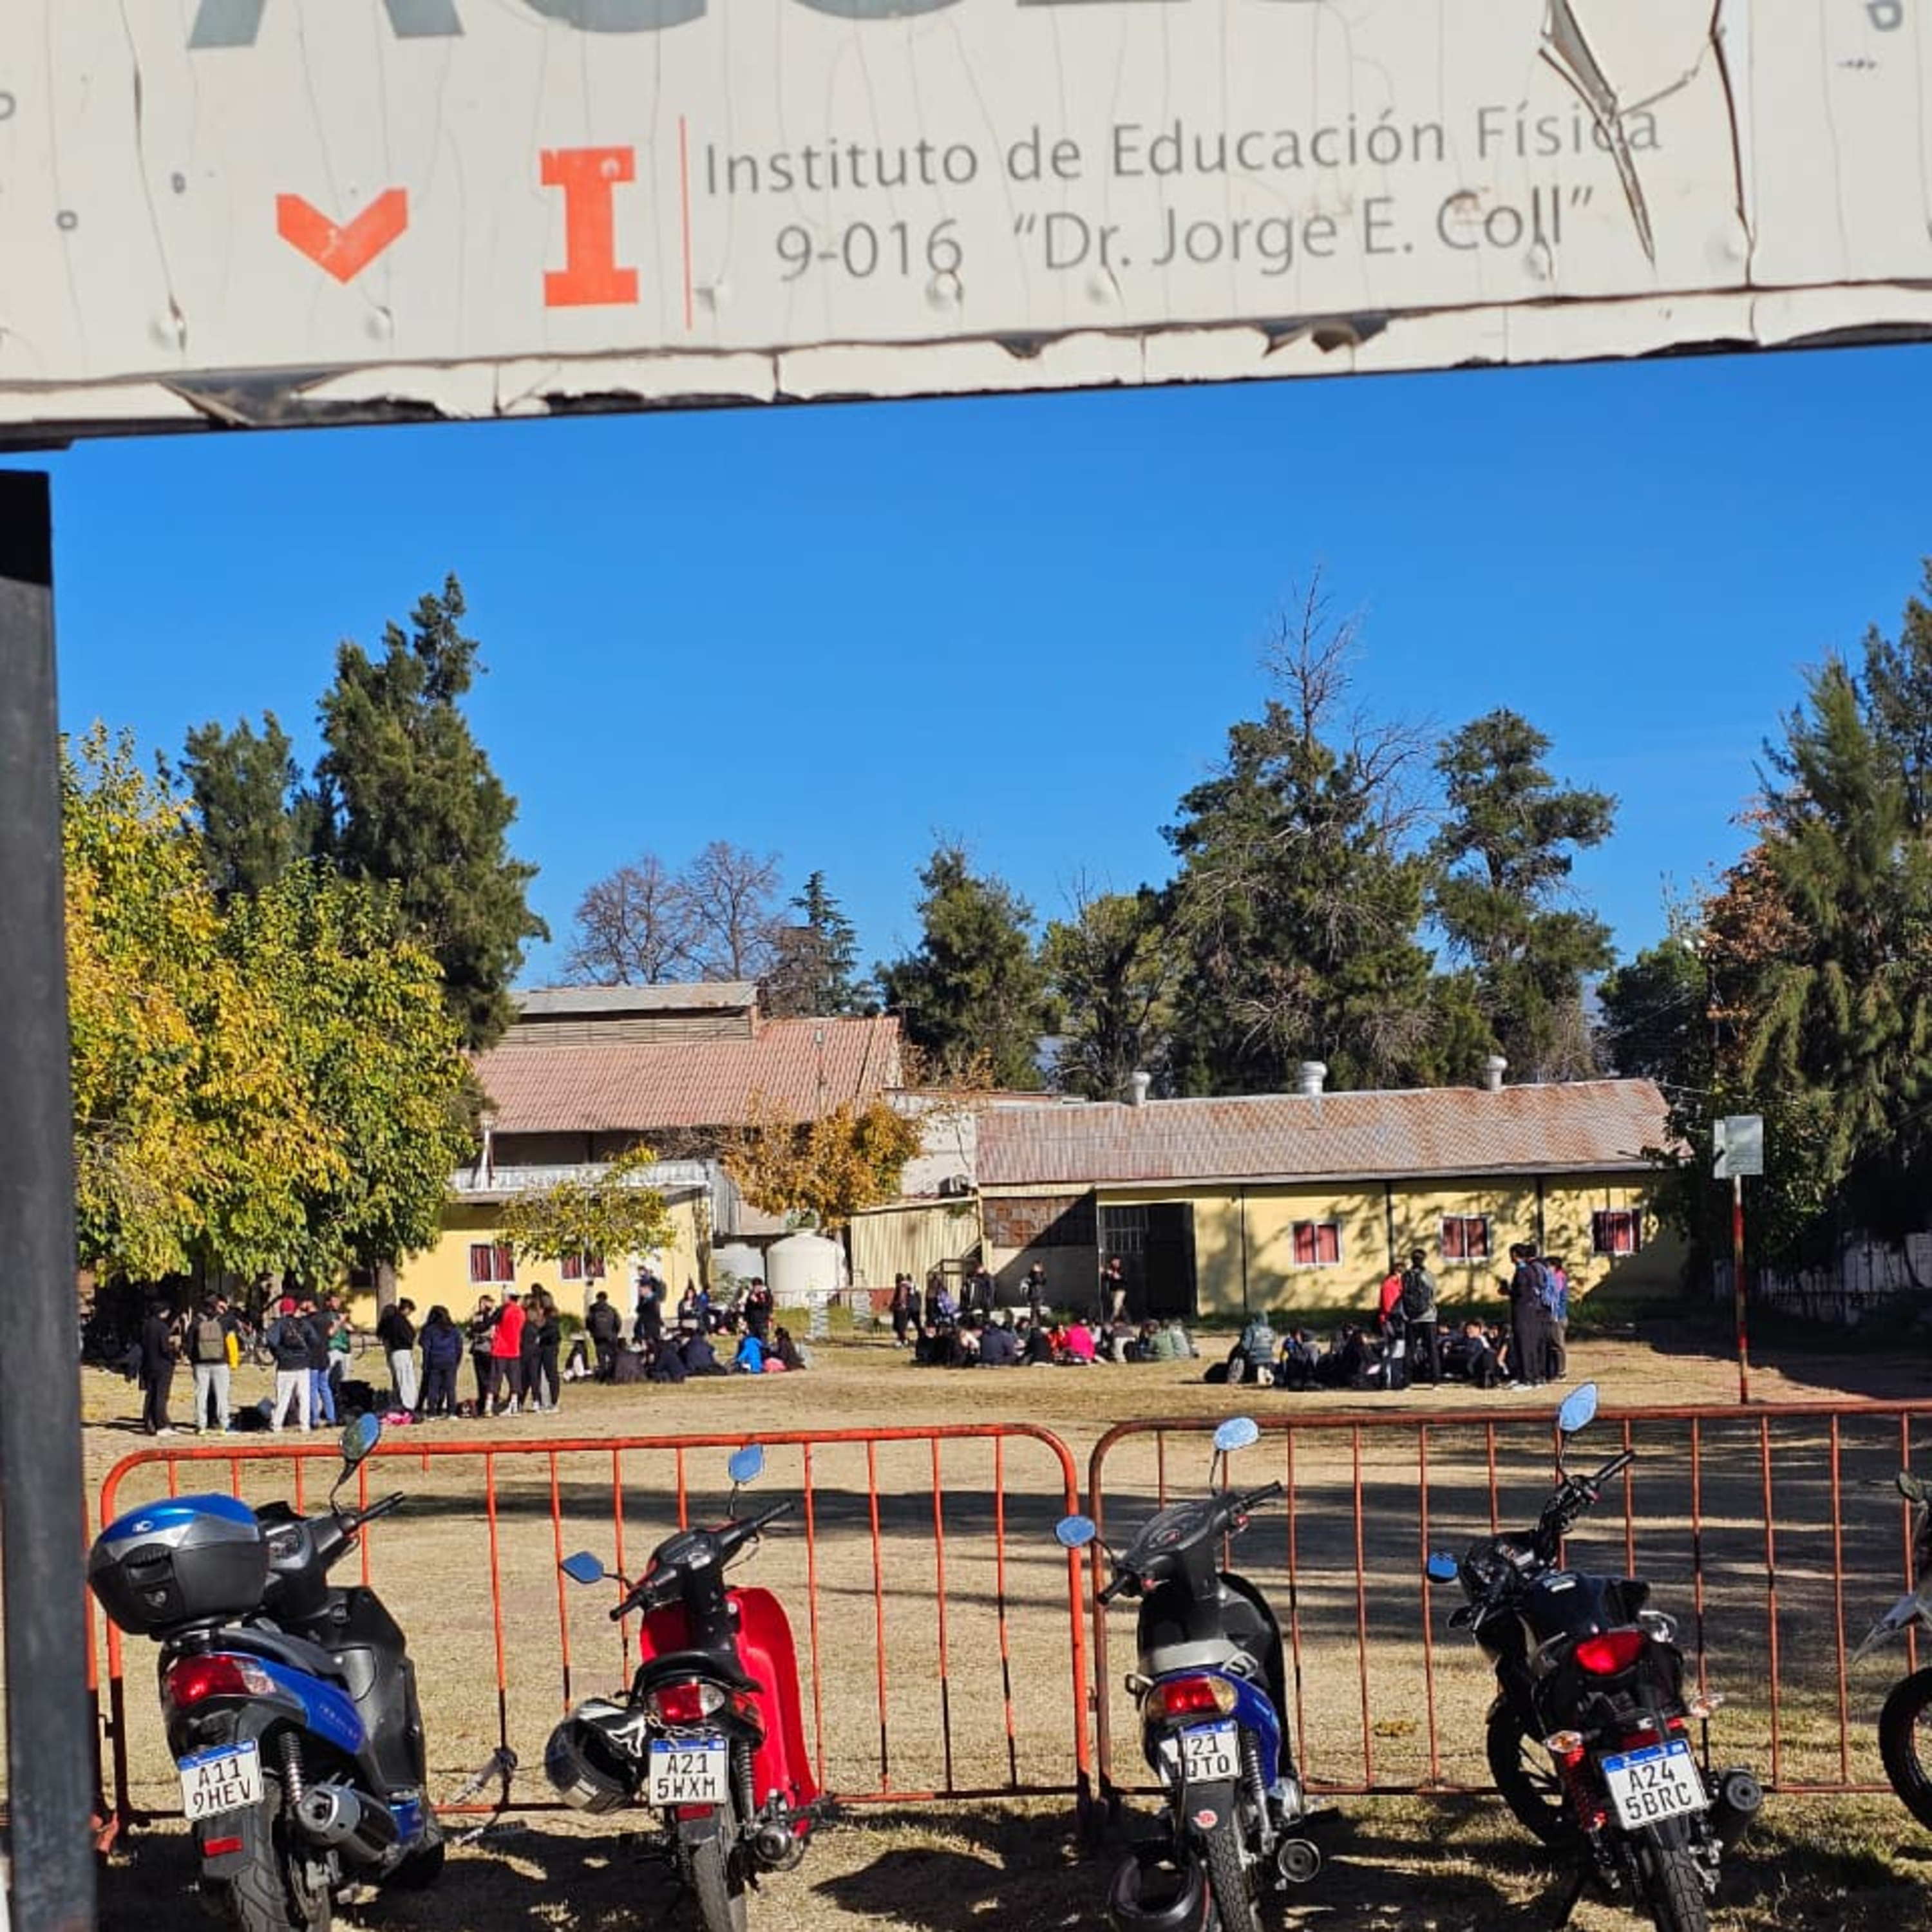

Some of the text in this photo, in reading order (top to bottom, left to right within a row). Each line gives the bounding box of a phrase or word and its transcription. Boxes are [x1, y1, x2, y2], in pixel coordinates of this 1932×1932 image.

[707, 100, 1662, 194] Instituto de Educación Física
[776, 219, 963, 282] 9-016
[1153, 208, 1338, 276] Jorge
[1363, 196, 1414, 254] E.
[199, 1757, 242, 1788] A11
[667, 1752, 709, 1775] A21
[1628, 1760, 1676, 1792] A24
[193, 1777, 251, 1814] 9HEV
[657, 1776, 716, 1799] 5WXM
[1625, 1781, 1692, 1821] 5BRC
